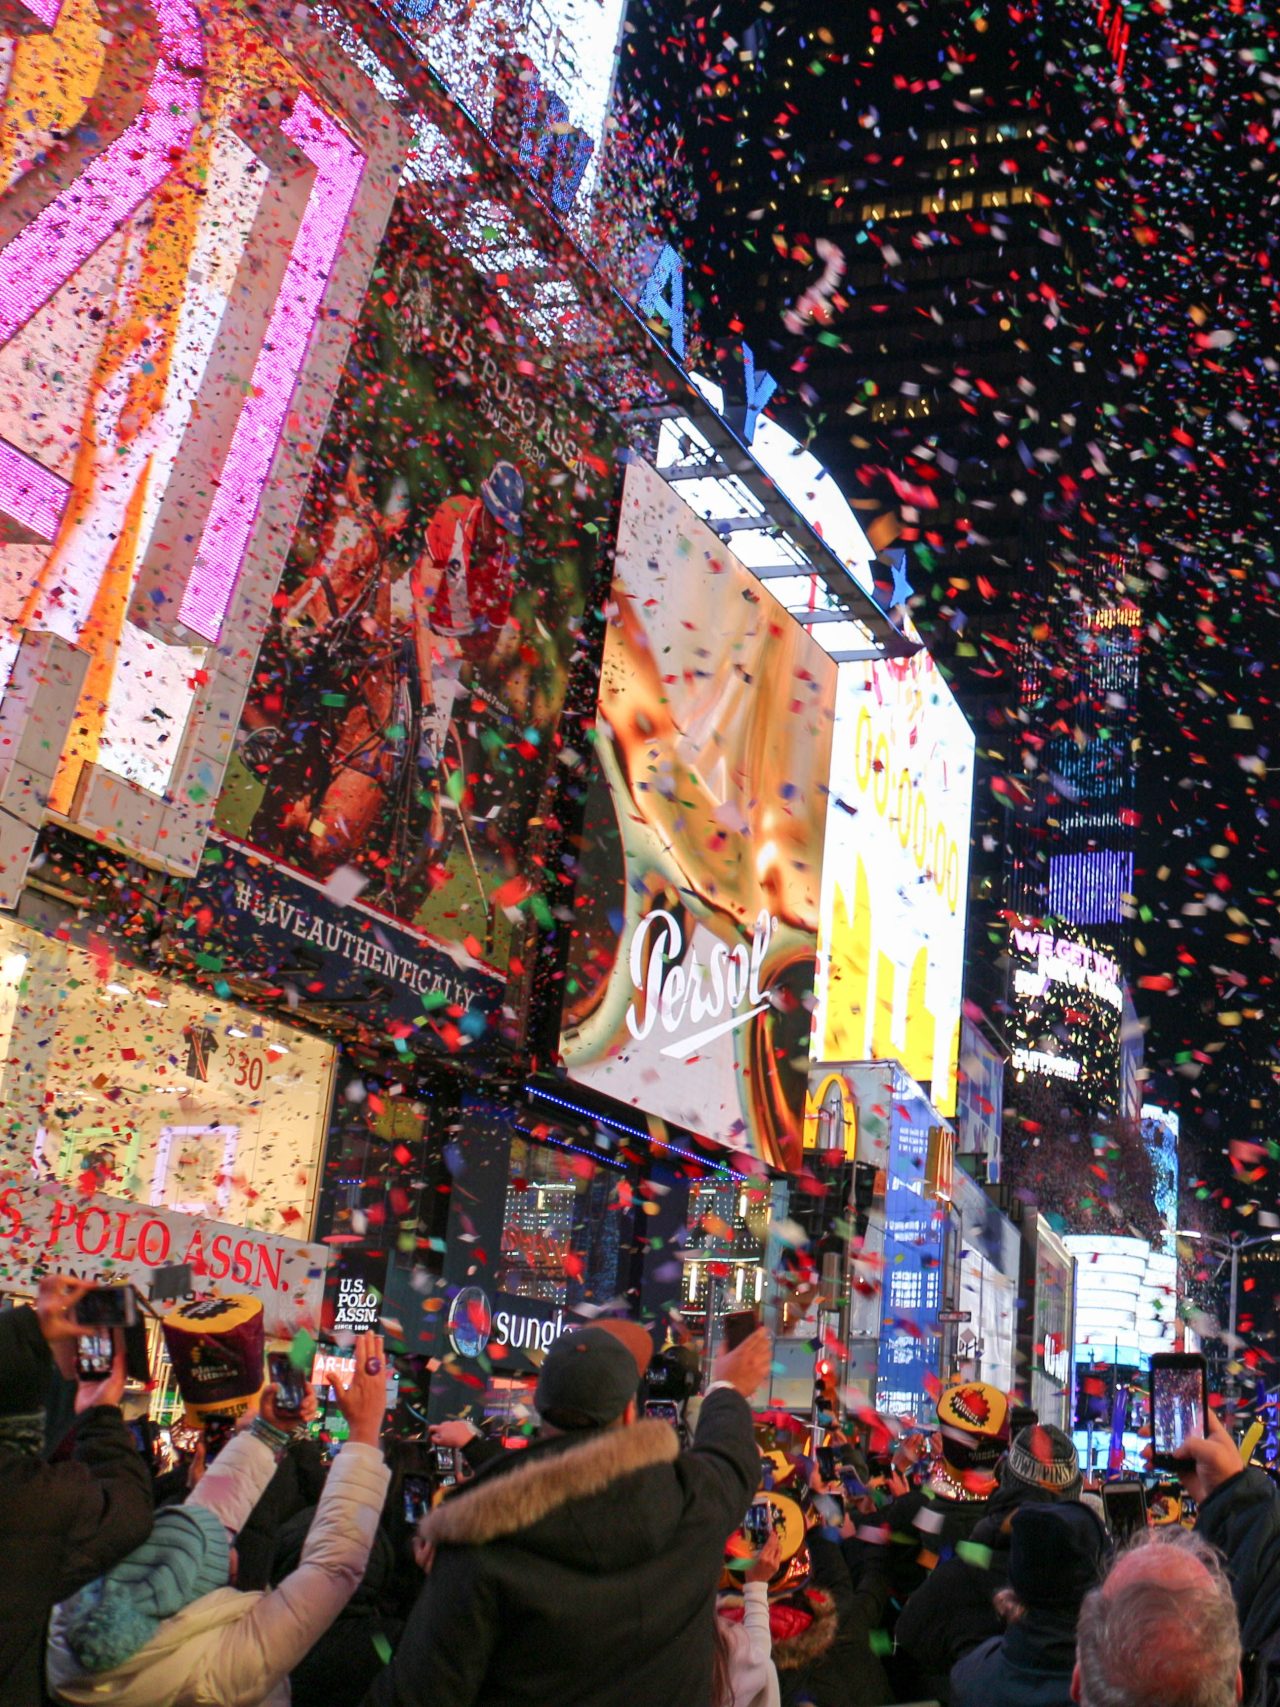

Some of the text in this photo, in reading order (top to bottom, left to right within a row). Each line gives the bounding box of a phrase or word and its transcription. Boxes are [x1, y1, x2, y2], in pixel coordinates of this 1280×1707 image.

[626, 909, 771, 1041] Persol
[1014, 928, 1054, 957] WE
[1055, 939, 1092, 969] GET
[1093, 950, 1119, 984] YOU
[48, 1199, 171, 1267] POLO
[182, 1229, 290, 1292] ASSN.
[337, 1293, 378, 1307] POLO
[340, 1279, 366, 1293] U.S.
[335, 1308, 378, 1322] ASSN.
[496, 1309, 573, 1356] sungl
